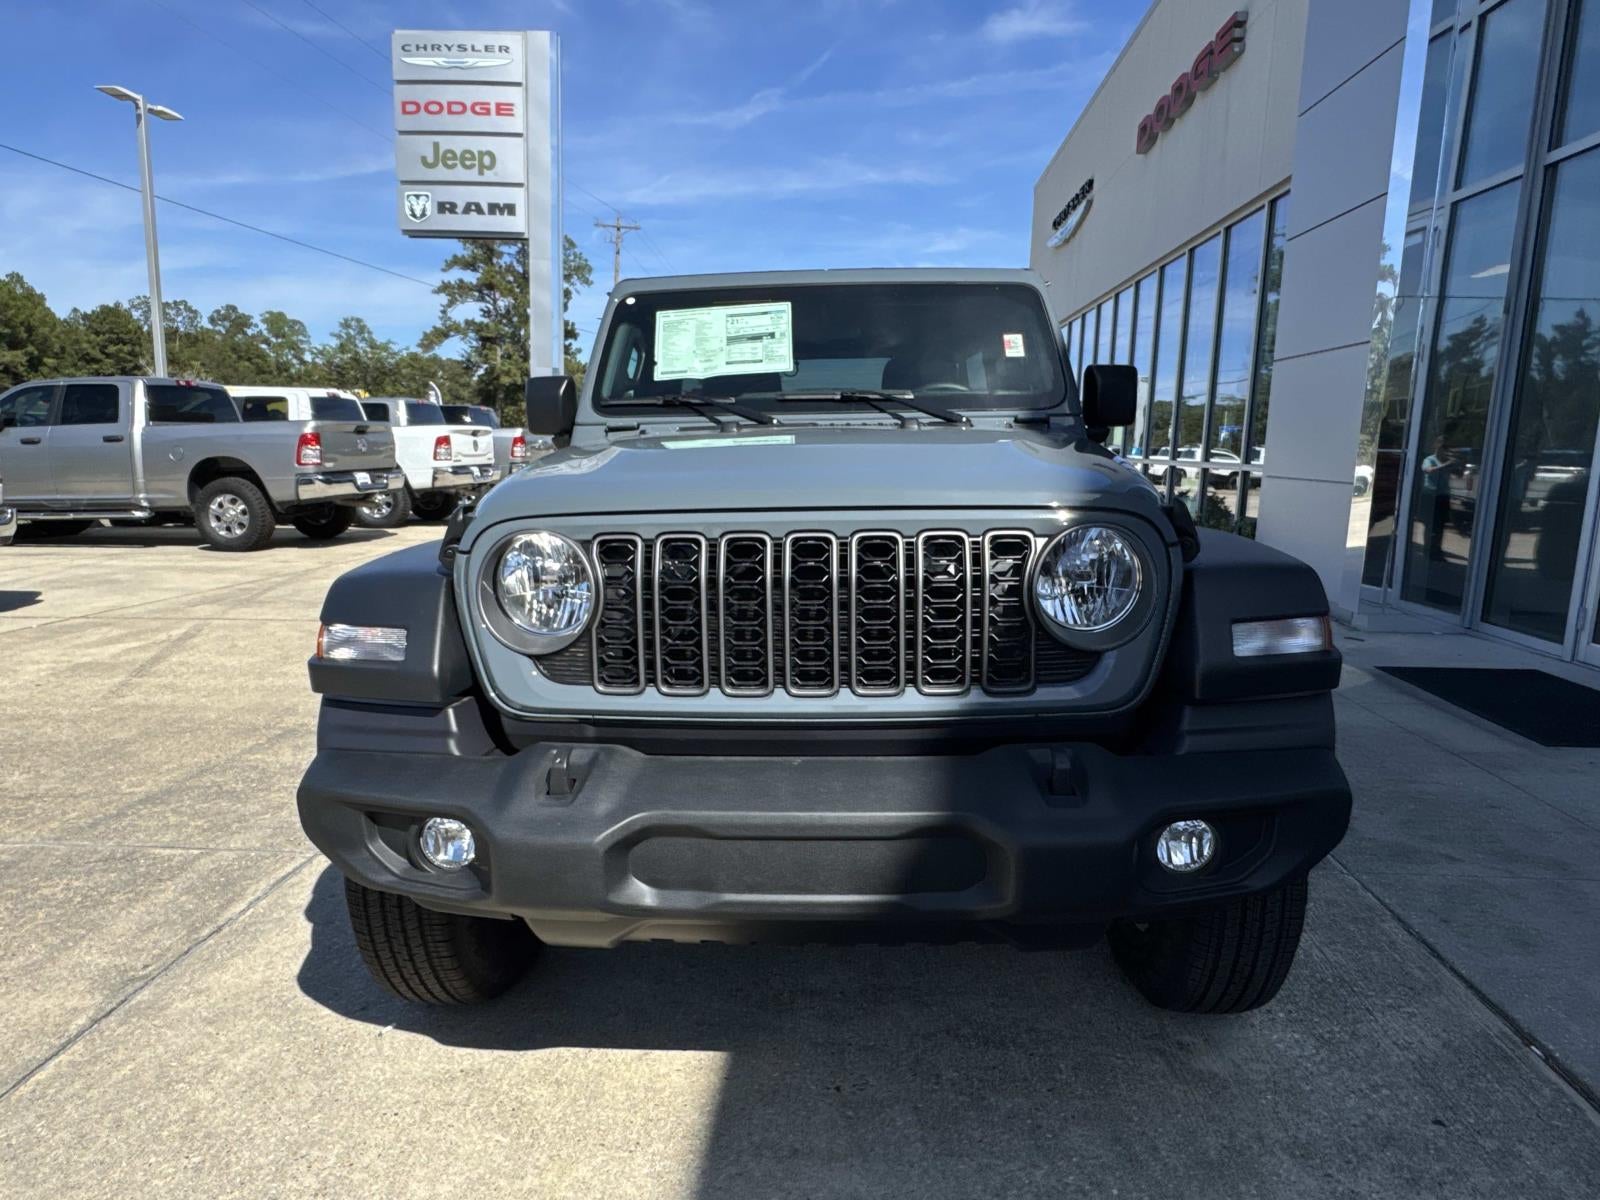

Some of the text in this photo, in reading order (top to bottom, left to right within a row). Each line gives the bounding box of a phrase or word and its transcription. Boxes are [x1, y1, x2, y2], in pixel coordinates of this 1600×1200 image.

[401, 43, 510, 54] CHRYSLER
[1136, 11, 1248, 155] DODGE
[401, 100, 514, 117] DODGE
[420, 141, 497, 176] Jeep
[437, 201, 516, 216] RAM
